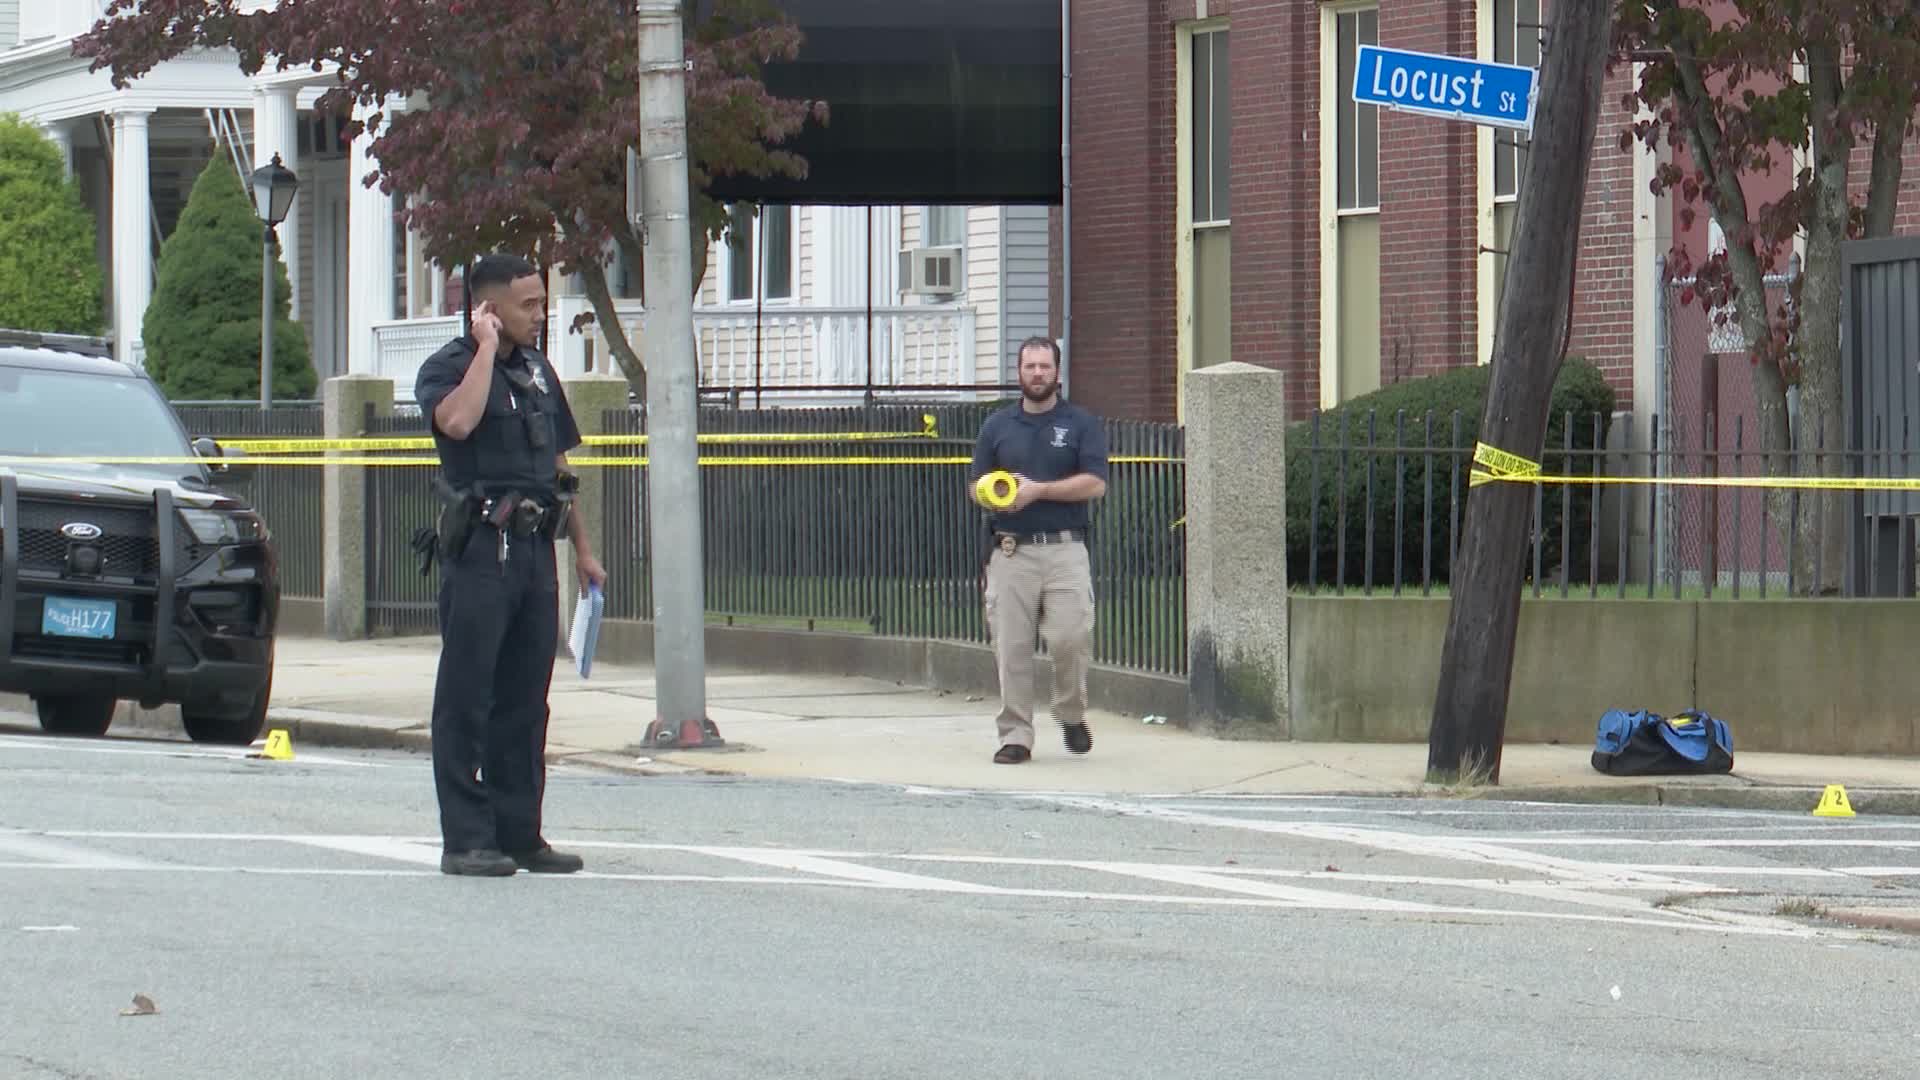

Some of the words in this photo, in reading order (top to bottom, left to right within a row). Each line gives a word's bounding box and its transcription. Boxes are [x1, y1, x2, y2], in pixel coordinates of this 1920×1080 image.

[1372, 54, 1485, 110] Locust
[1498, 90, 1517, 113] St
[71, 607, 112, 630] H177
[273, 735, 282, 749] 7
[1834, 790, 1843, 806] 2
